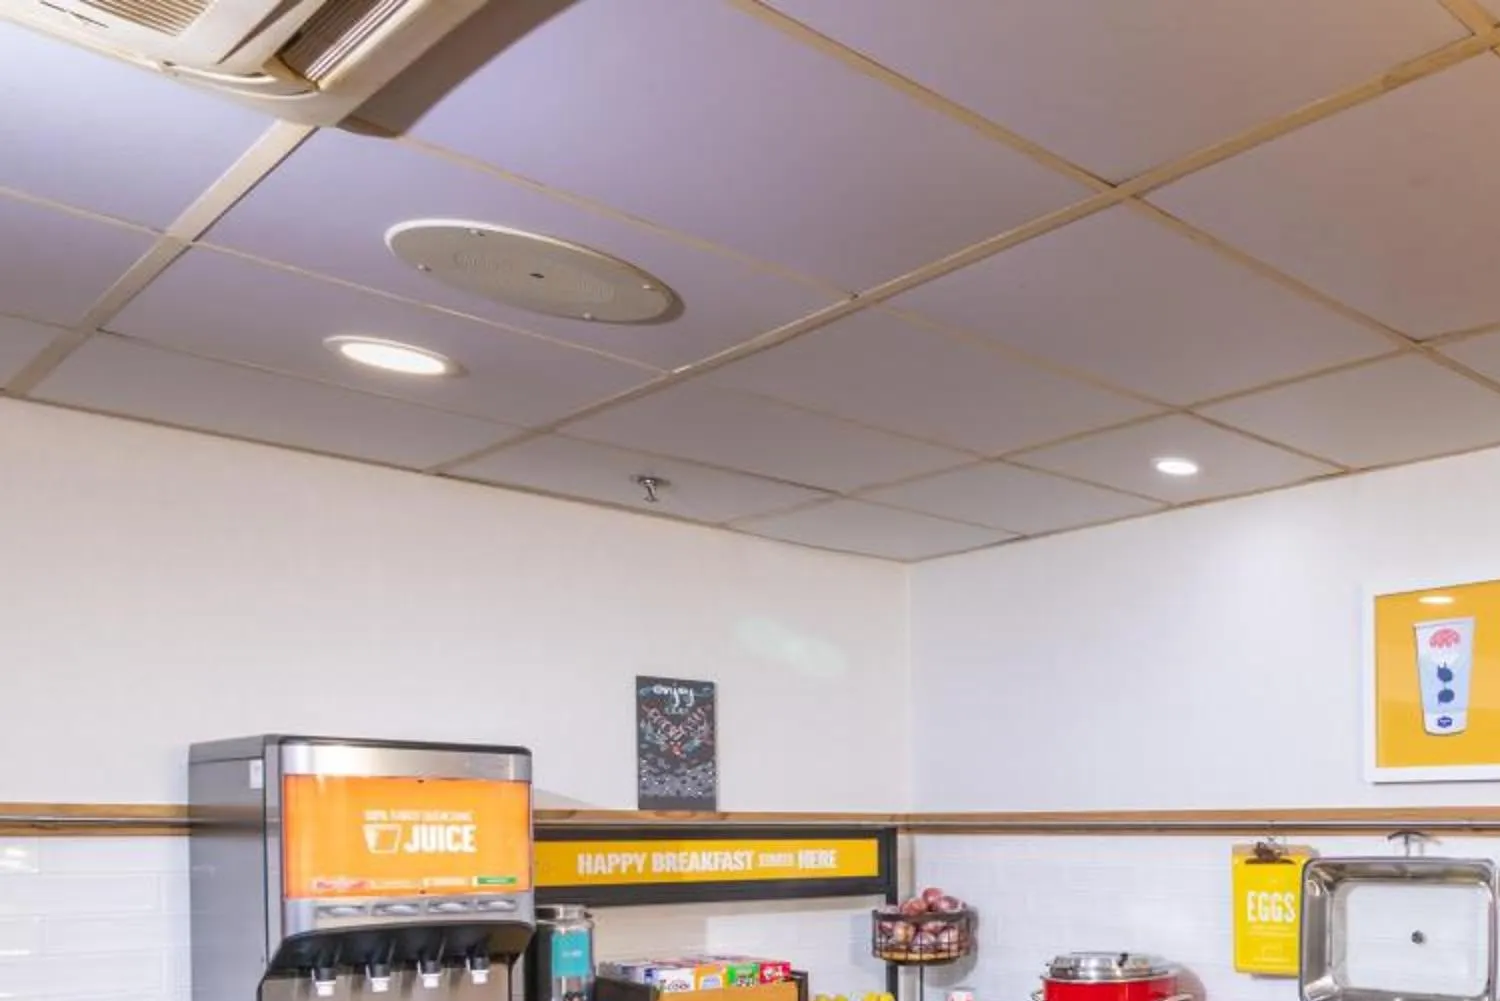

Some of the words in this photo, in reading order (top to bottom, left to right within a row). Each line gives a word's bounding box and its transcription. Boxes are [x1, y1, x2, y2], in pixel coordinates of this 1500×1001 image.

[403, 823, 478, 853] JUICE
[577, 852, 648, 875] HAPPY
[651, 850, 754, 873] BREAKFAST
[798, 849, 837, 869] HERE
[1246, 891, 1297, 923] EGGS
